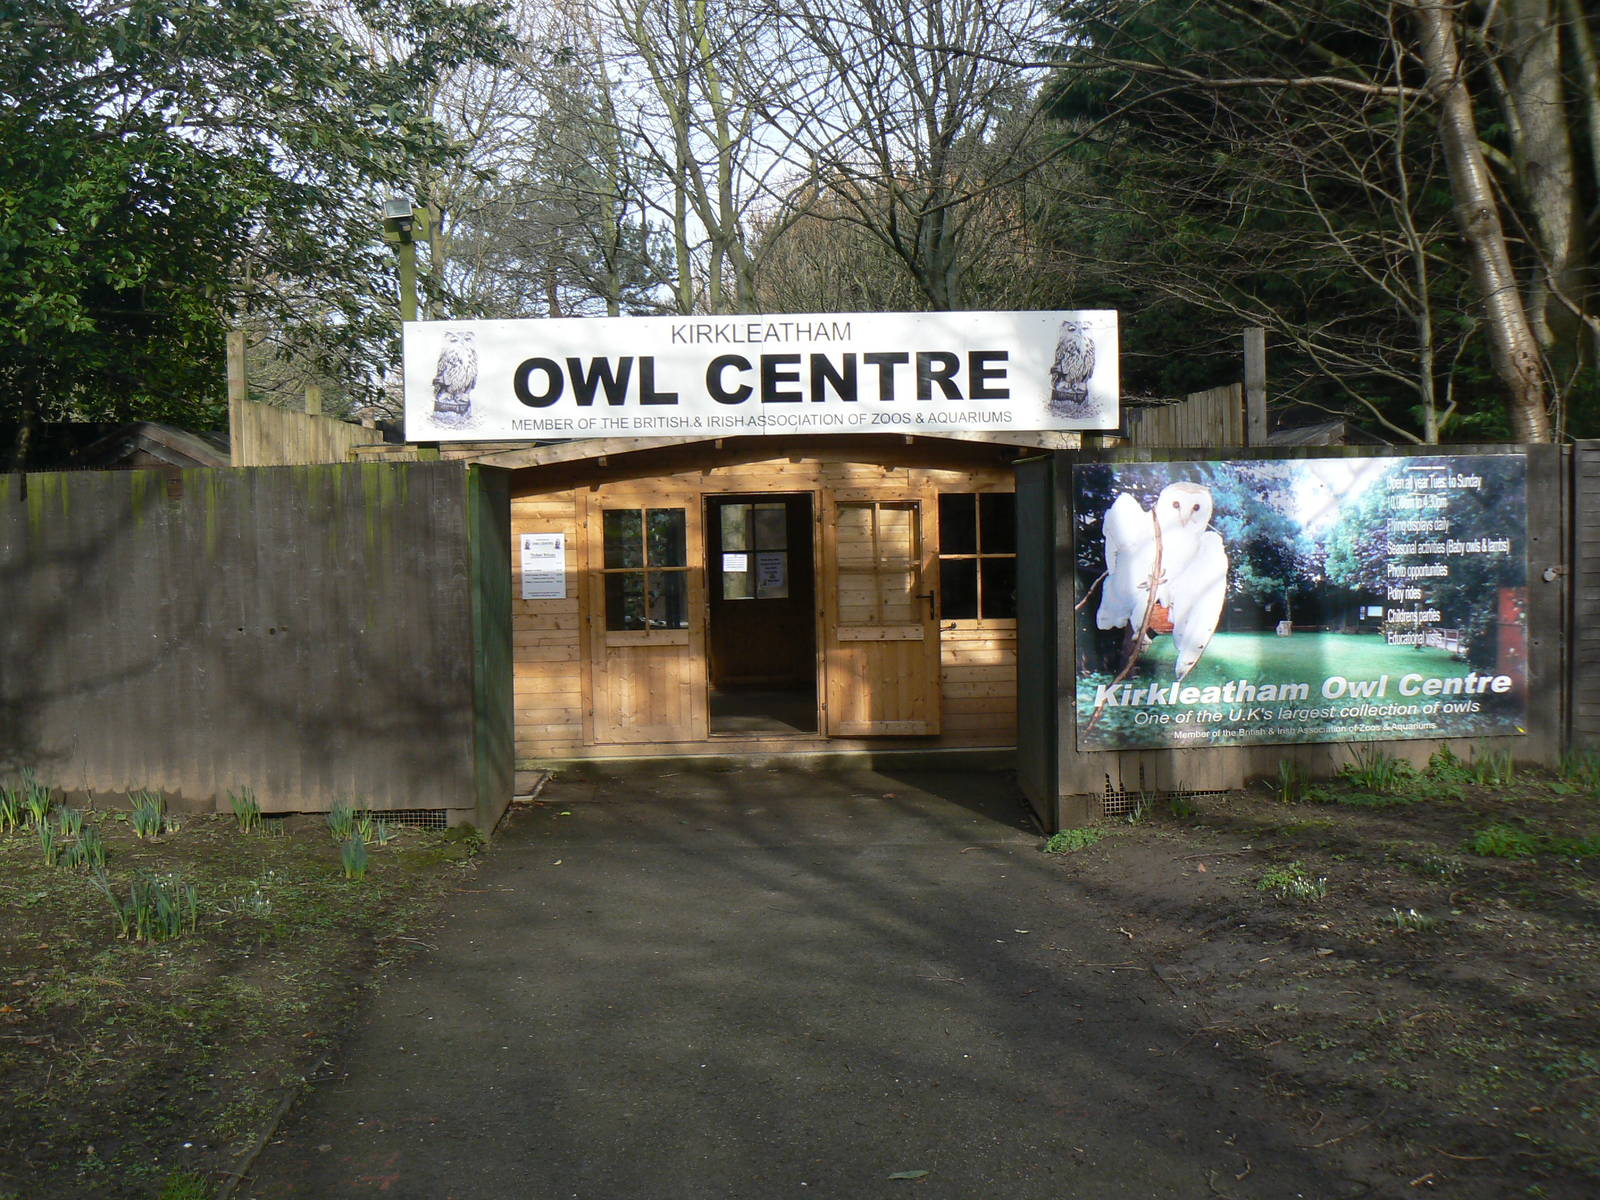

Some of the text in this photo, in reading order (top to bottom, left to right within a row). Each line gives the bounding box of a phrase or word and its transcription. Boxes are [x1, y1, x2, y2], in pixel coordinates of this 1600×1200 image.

[671, 322, 851, 344] KIRKLEATHAM
[513, 350, 1010, 408] OWL CENTRE
[512, 411, 1012, 431] MEMBER OF THE BRITISH & IRISH ASSOCIATION OF ZOOS & AQUARIUMS
[1414, 476, 1429, 491] year
[1448, 474, 1456, 488] to
[1457, 473, 1482, 490] Sunday
[1387, 517, 1449, 534] Flying displays daily
[1387, 537, 1510, 556] Seasonal activities (Baby owls & lambs)
[1387, 562, 1448, 580] Photo opportunities
[1387, 586, 1421, 603] Pony rides
[1418, 607, 1440, 625] parties
[1387, 631, 1425, 645] Educational
[1094, 672, 1512, 707] Kirkleatham Owl Centre
[1134, 700, 1480, 725] One of the U.K's largest collection of owls
[1174, 729, 1210, 739] Member
[1212, 729, 1221, 738] of
[1222, 729, 1236, 737] the
[1239, 728, 1266, 737] British
[1267, 728, 1275, 736] &
[1277, 728, 1295, 736] Irish
[1297, 725, 1347, 735] Association
[1349, 724, 1358, 733] of
[1359, 723, 1381, 732] Zoos
[1383, 723, 1390, 731] &
